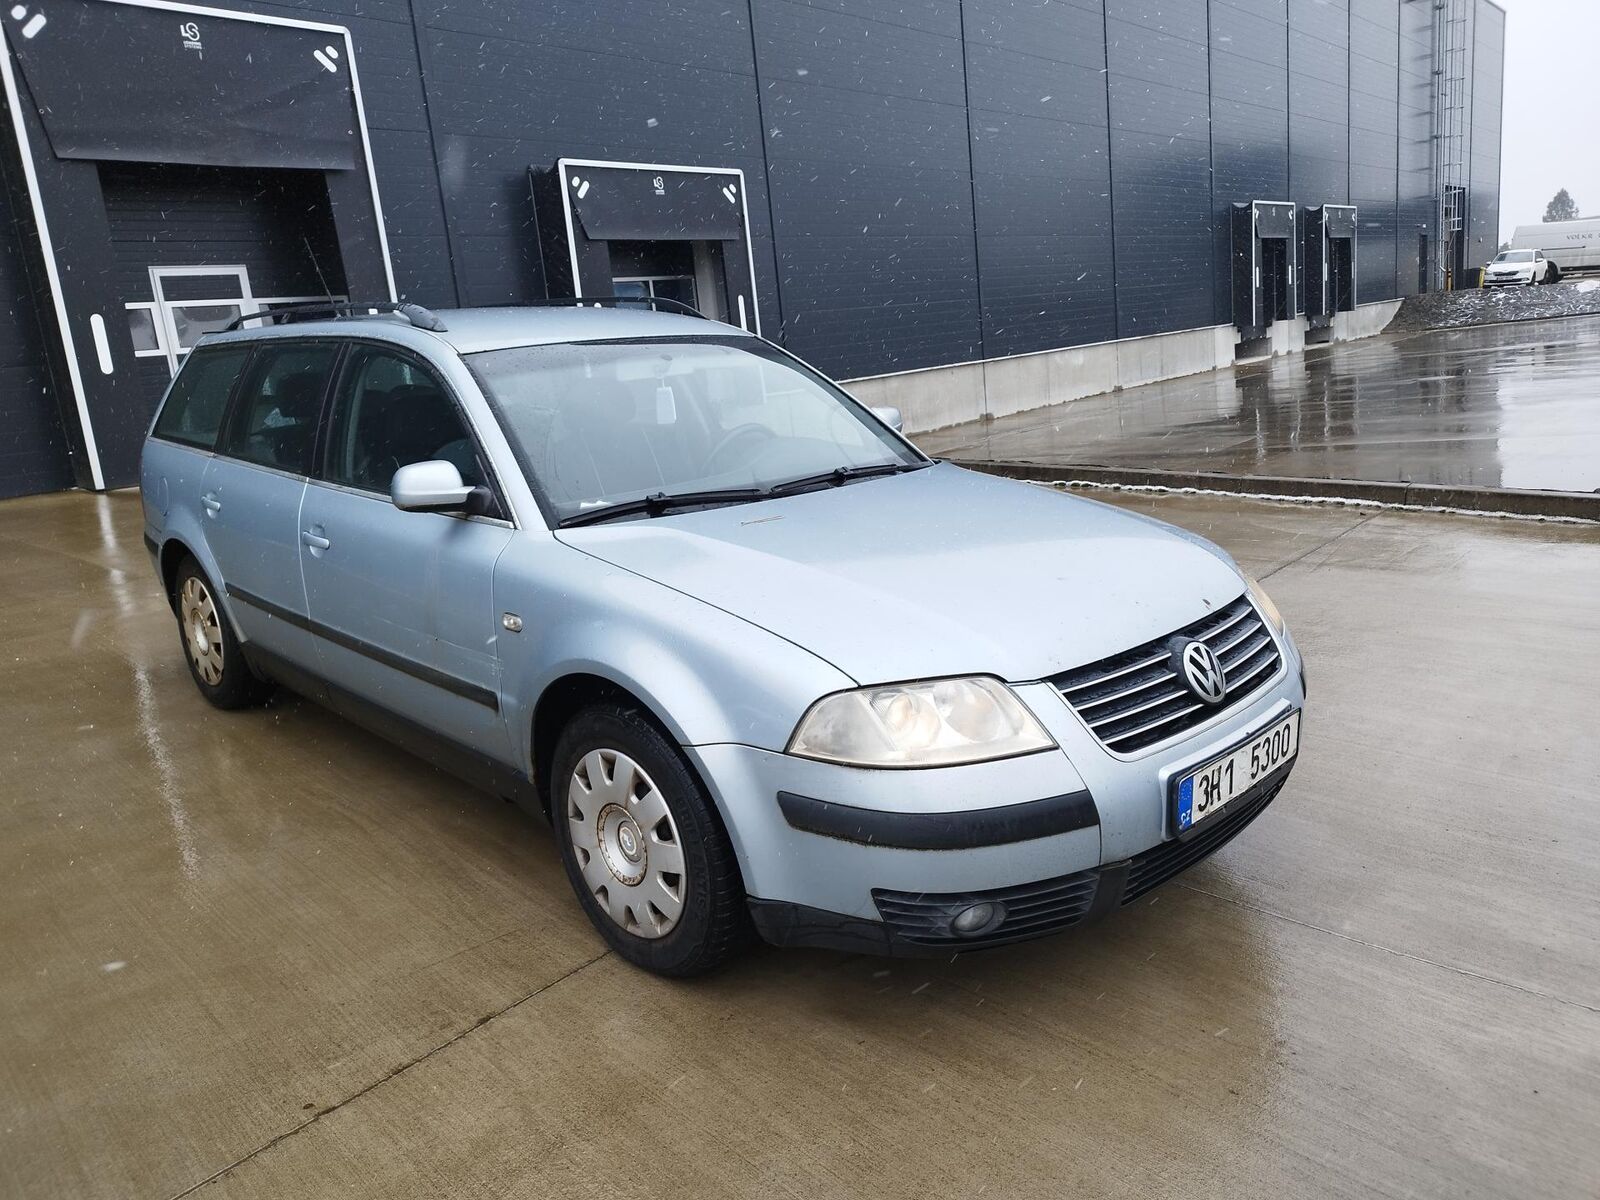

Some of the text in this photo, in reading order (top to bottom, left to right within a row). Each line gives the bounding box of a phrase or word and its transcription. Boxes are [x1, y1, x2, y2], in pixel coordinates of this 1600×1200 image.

[1197, 723, 1291, 812] 3H1 5300
[1181, 809, 1191, 823] CZ
